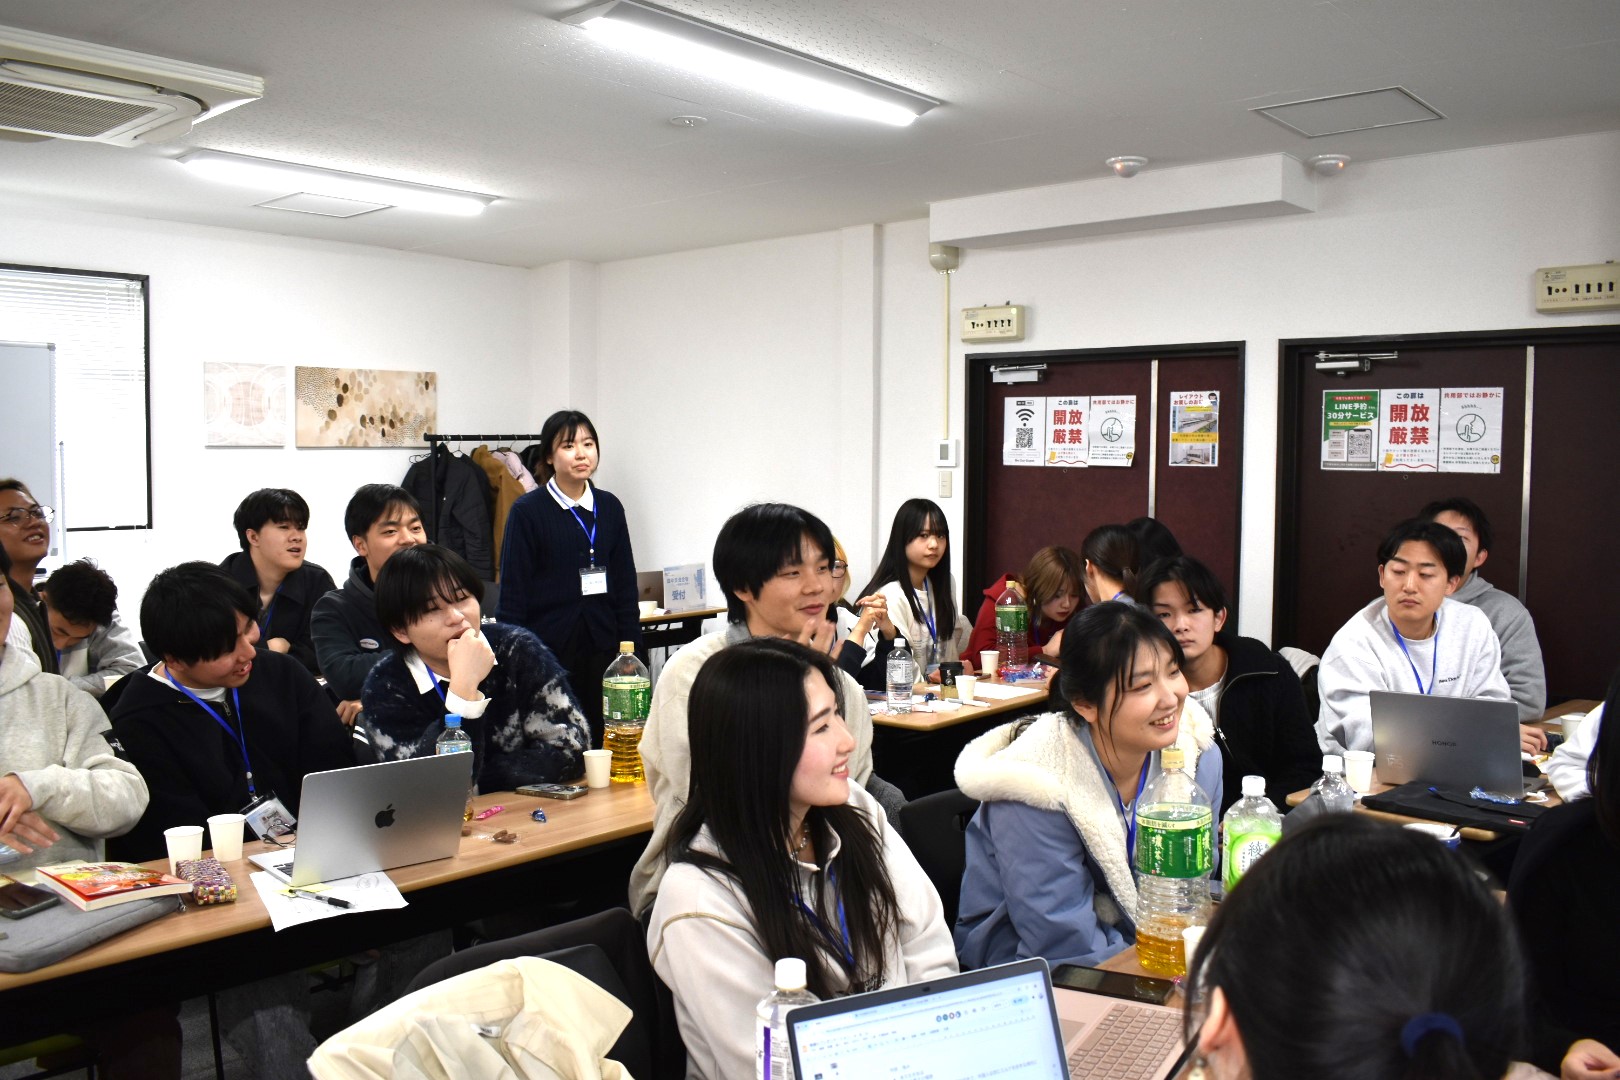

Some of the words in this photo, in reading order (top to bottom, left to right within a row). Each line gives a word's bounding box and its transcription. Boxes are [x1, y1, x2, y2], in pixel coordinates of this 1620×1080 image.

[1053, 409, 1083, 425] 開放
[1327, 412, 1375, 420] 30分サービス
[1390, 404, 1430, 423] 開放
[1052, 428, 1082, 444] 厳禁
[1389, 426, 1429, 445] 厳禁
[672, 589, 686, 601] 受付
